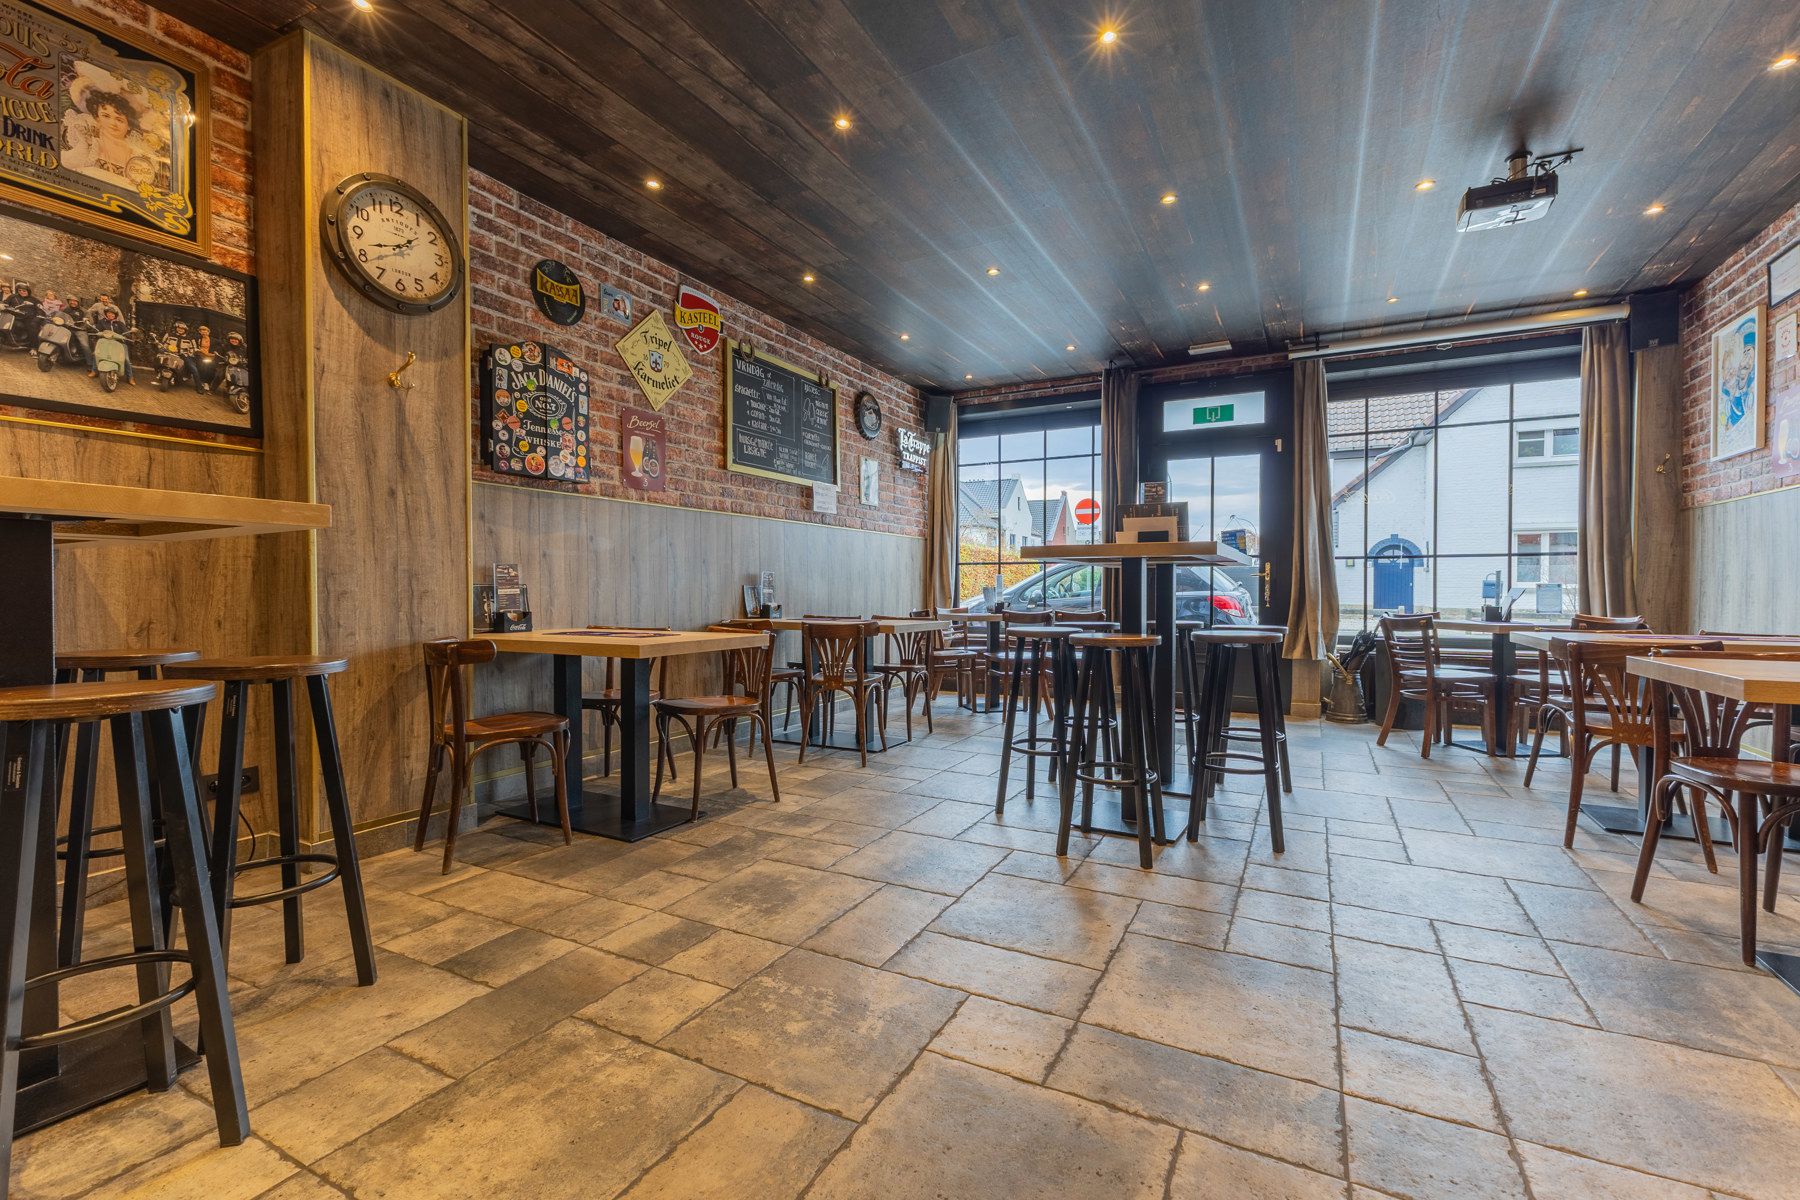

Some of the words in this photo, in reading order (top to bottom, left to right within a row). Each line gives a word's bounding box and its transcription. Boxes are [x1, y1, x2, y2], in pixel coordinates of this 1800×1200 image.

[2, 114, 56, 152] DRINK
[355, 205, 370, 222] 10
[371, 198, 383, 215] 11
[389, 198, 404, 218] 12
[415, 213, 420, 227] 1
[352, 225, 364, 240] 9
[427, 231, 438, 247] 2
[358, 248, 369, 264] 8
[434, 253, 445, 268] 3
[375, 265, 387, 281] 7
[428, 271, 441, 285] 4
[395, 278, 406, 293] 6
[414, 277, 425, 293] 5
[679, 310, 719, 328] KASTEEL
[640, 329, 673, 352] Tripel
[633, 361, 680, 391] Karmeliet
[510, 371, 539, 390] JACK
[538, 368, 578, 403] DANIEL'S
[627, 416, 660, 431] Beersel
[902, 450, 928, 467] TRAPPIST
